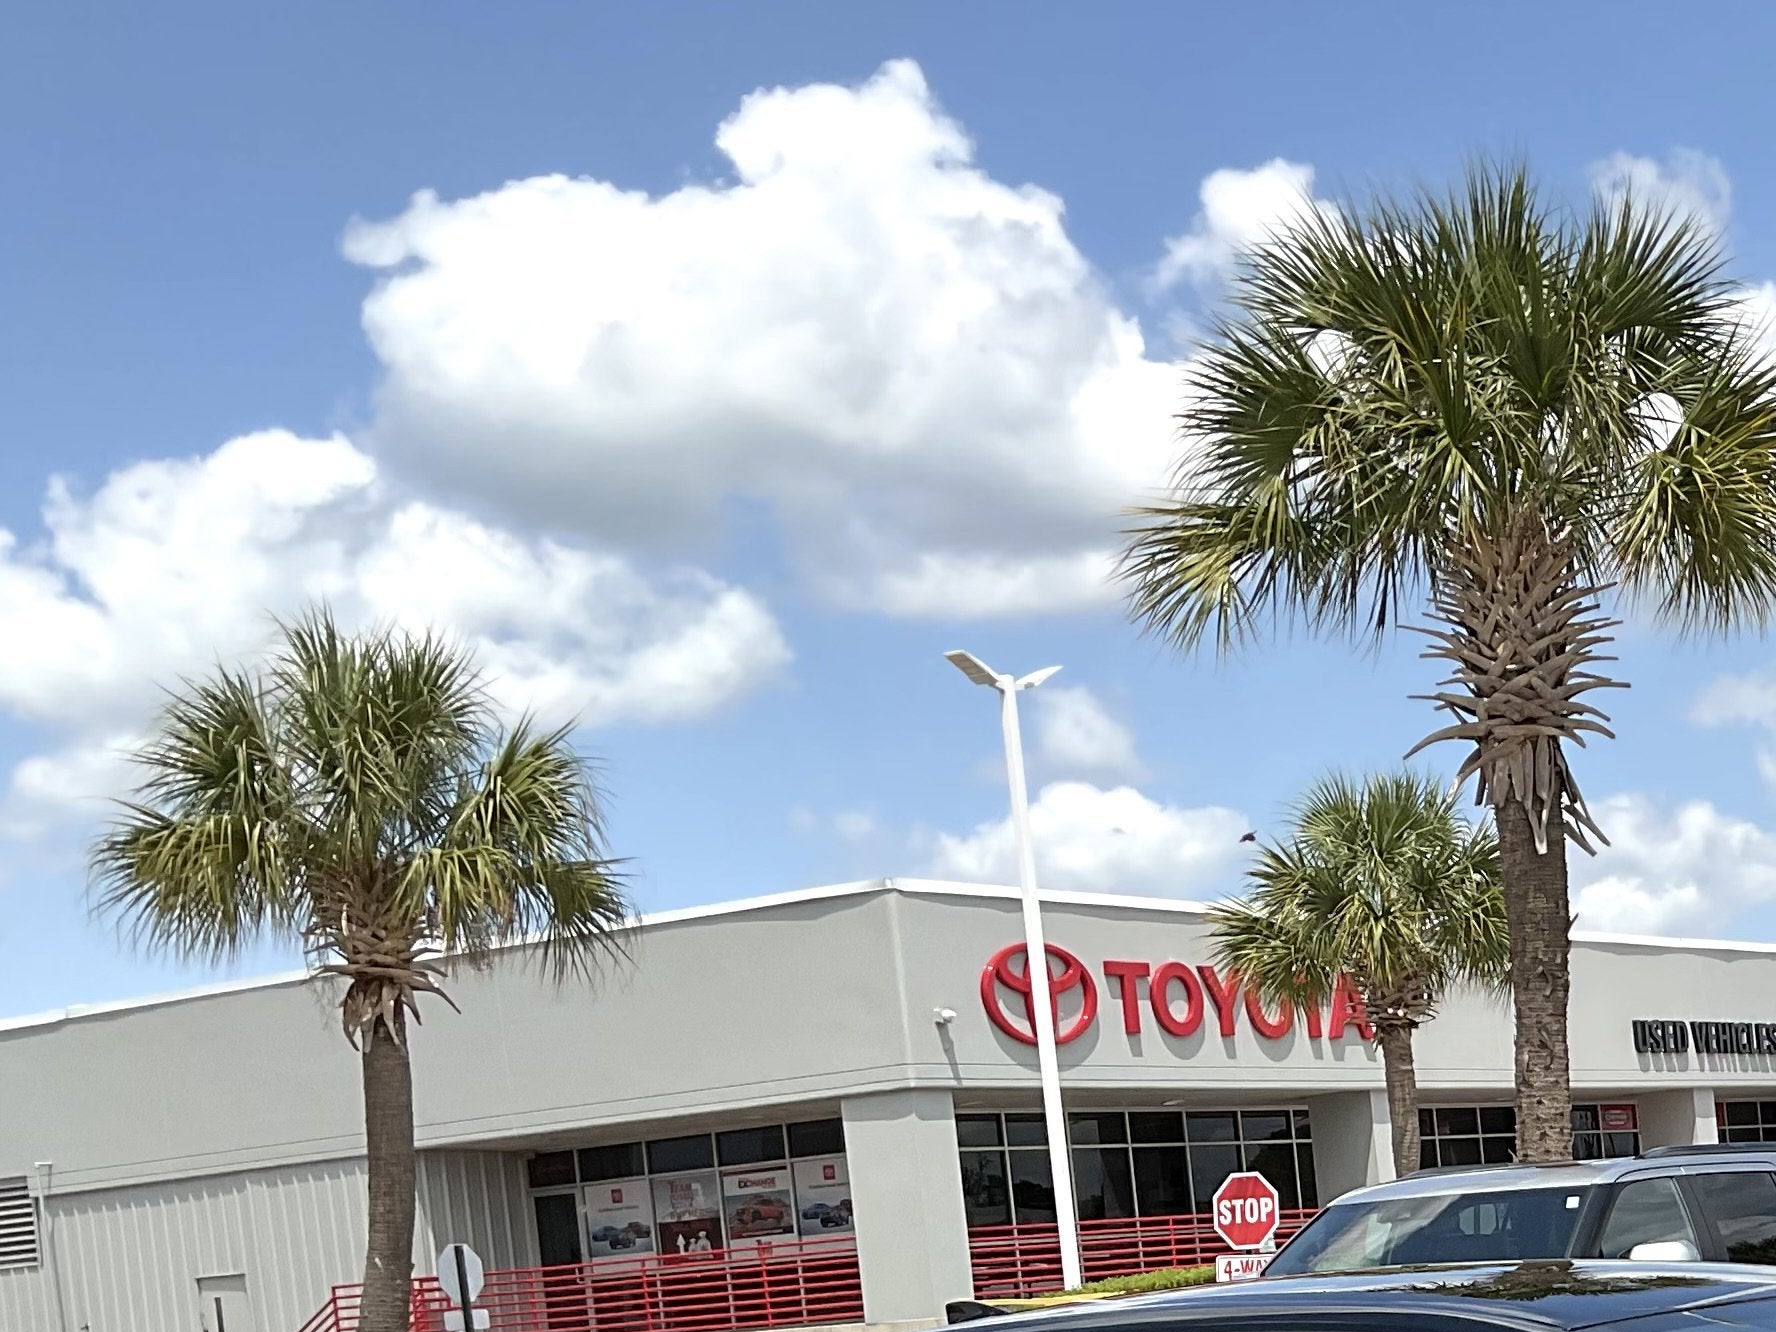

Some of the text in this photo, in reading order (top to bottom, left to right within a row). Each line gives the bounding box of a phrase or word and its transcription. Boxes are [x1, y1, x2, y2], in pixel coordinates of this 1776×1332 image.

[1632, 1020, 1689, 1053] USED
[1219, 1197, 1273, 1225] STOP
[1224, 1258, 1269, 1280] 4-WA
